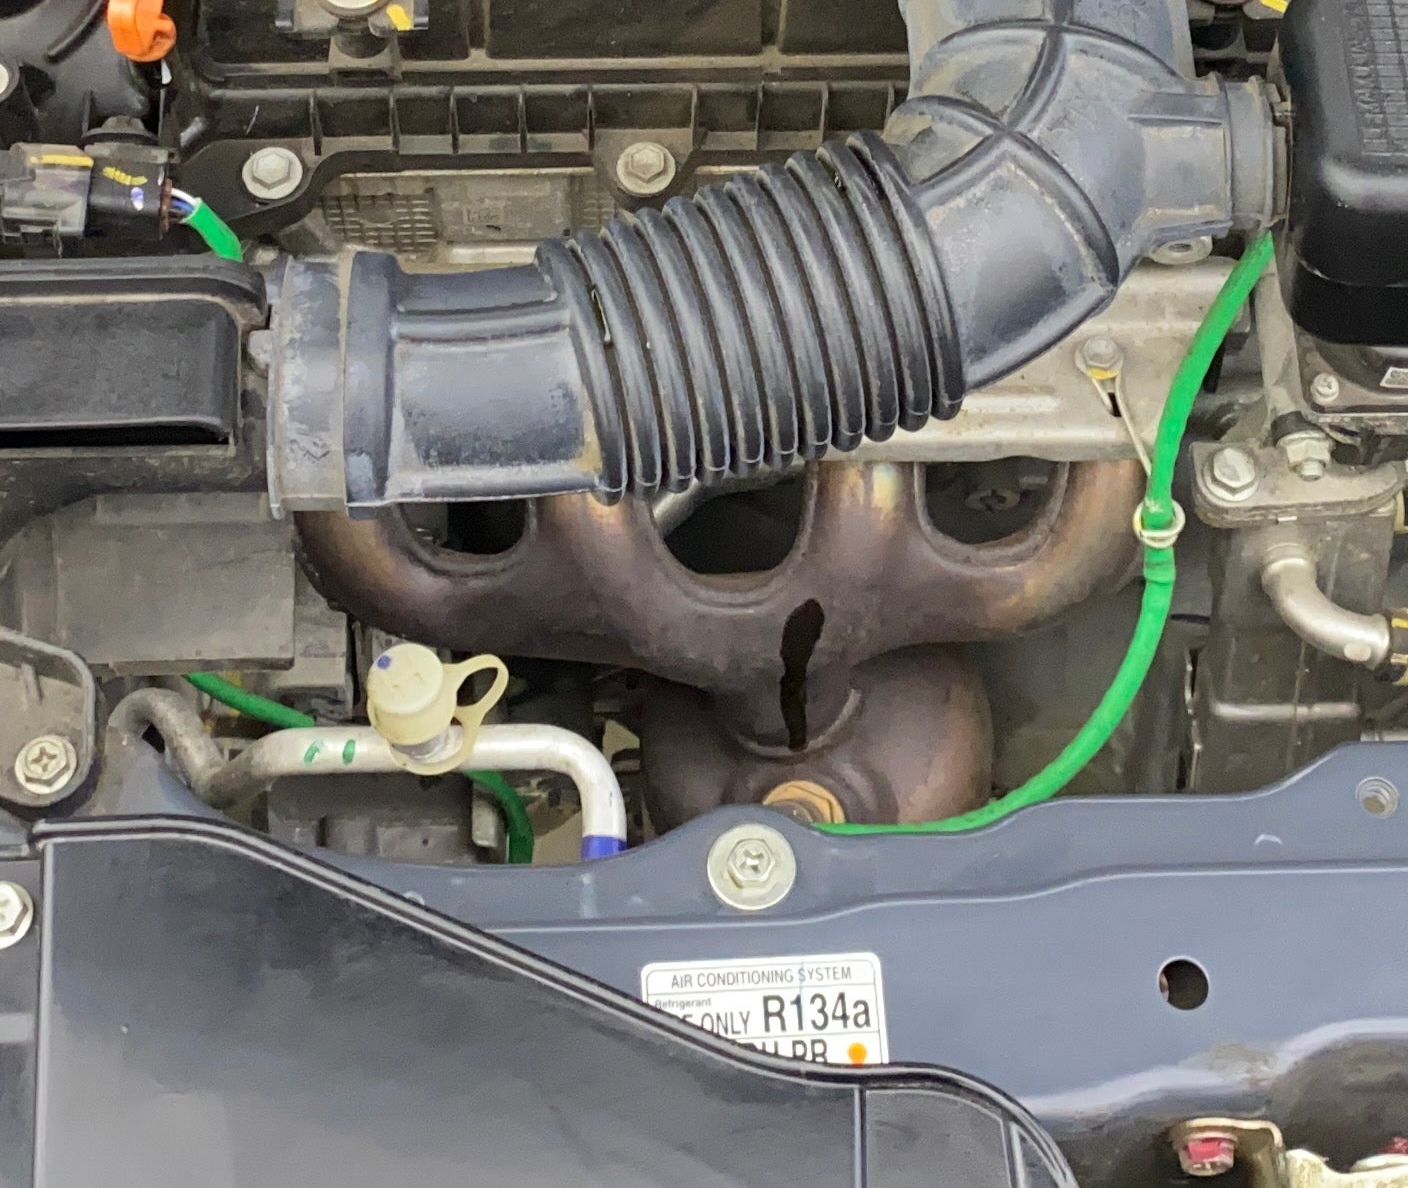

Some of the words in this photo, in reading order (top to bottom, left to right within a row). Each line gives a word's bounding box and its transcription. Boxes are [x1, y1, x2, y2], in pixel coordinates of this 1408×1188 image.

[671, 974, 693, 989] AIR
[697, 969, 794, 987] CONDITIONING
[798, 966, 852, 982] SYSTEM
[655, 998, 712, 1011] Refrigerant
[701, 1010, 751, 1036] ONLY
[763, 992, 871, 1032] R134a
